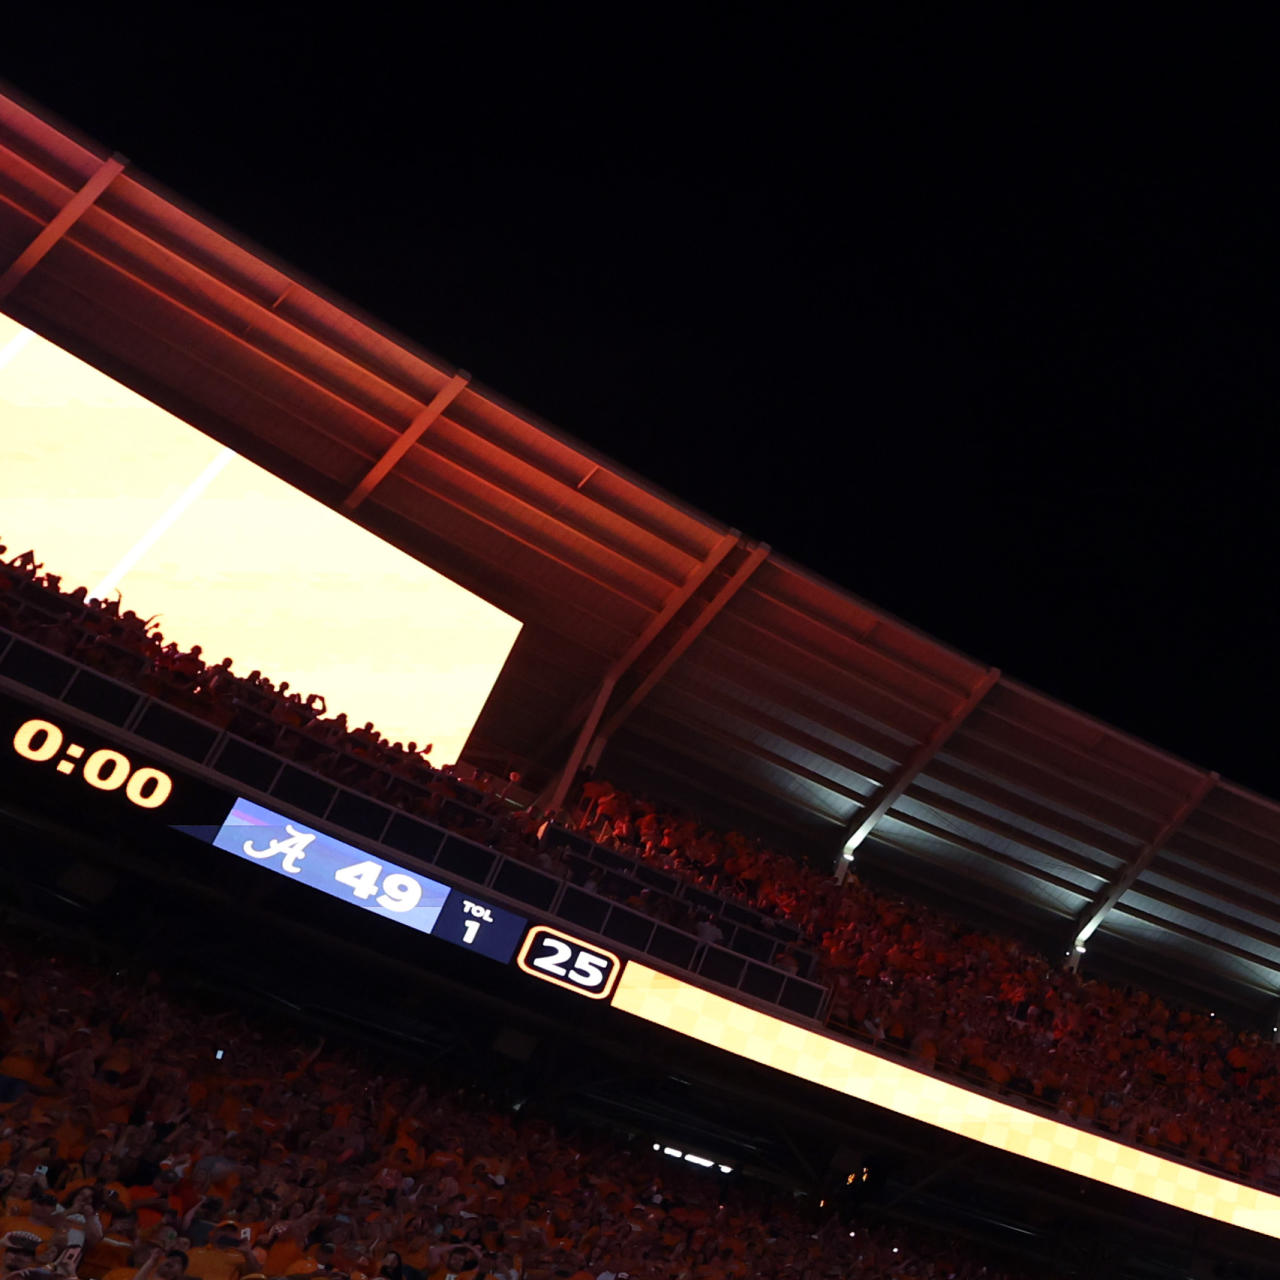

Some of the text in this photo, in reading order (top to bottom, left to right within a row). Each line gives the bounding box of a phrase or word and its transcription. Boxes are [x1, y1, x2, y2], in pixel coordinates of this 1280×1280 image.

[13, 719, 172, 809] 0:00
[335, 860, 422, 912] 49
[462, 920, 480, 944] 1
[463, 900, 494, 923] TOL
[533, 938, 608, 987] 25
